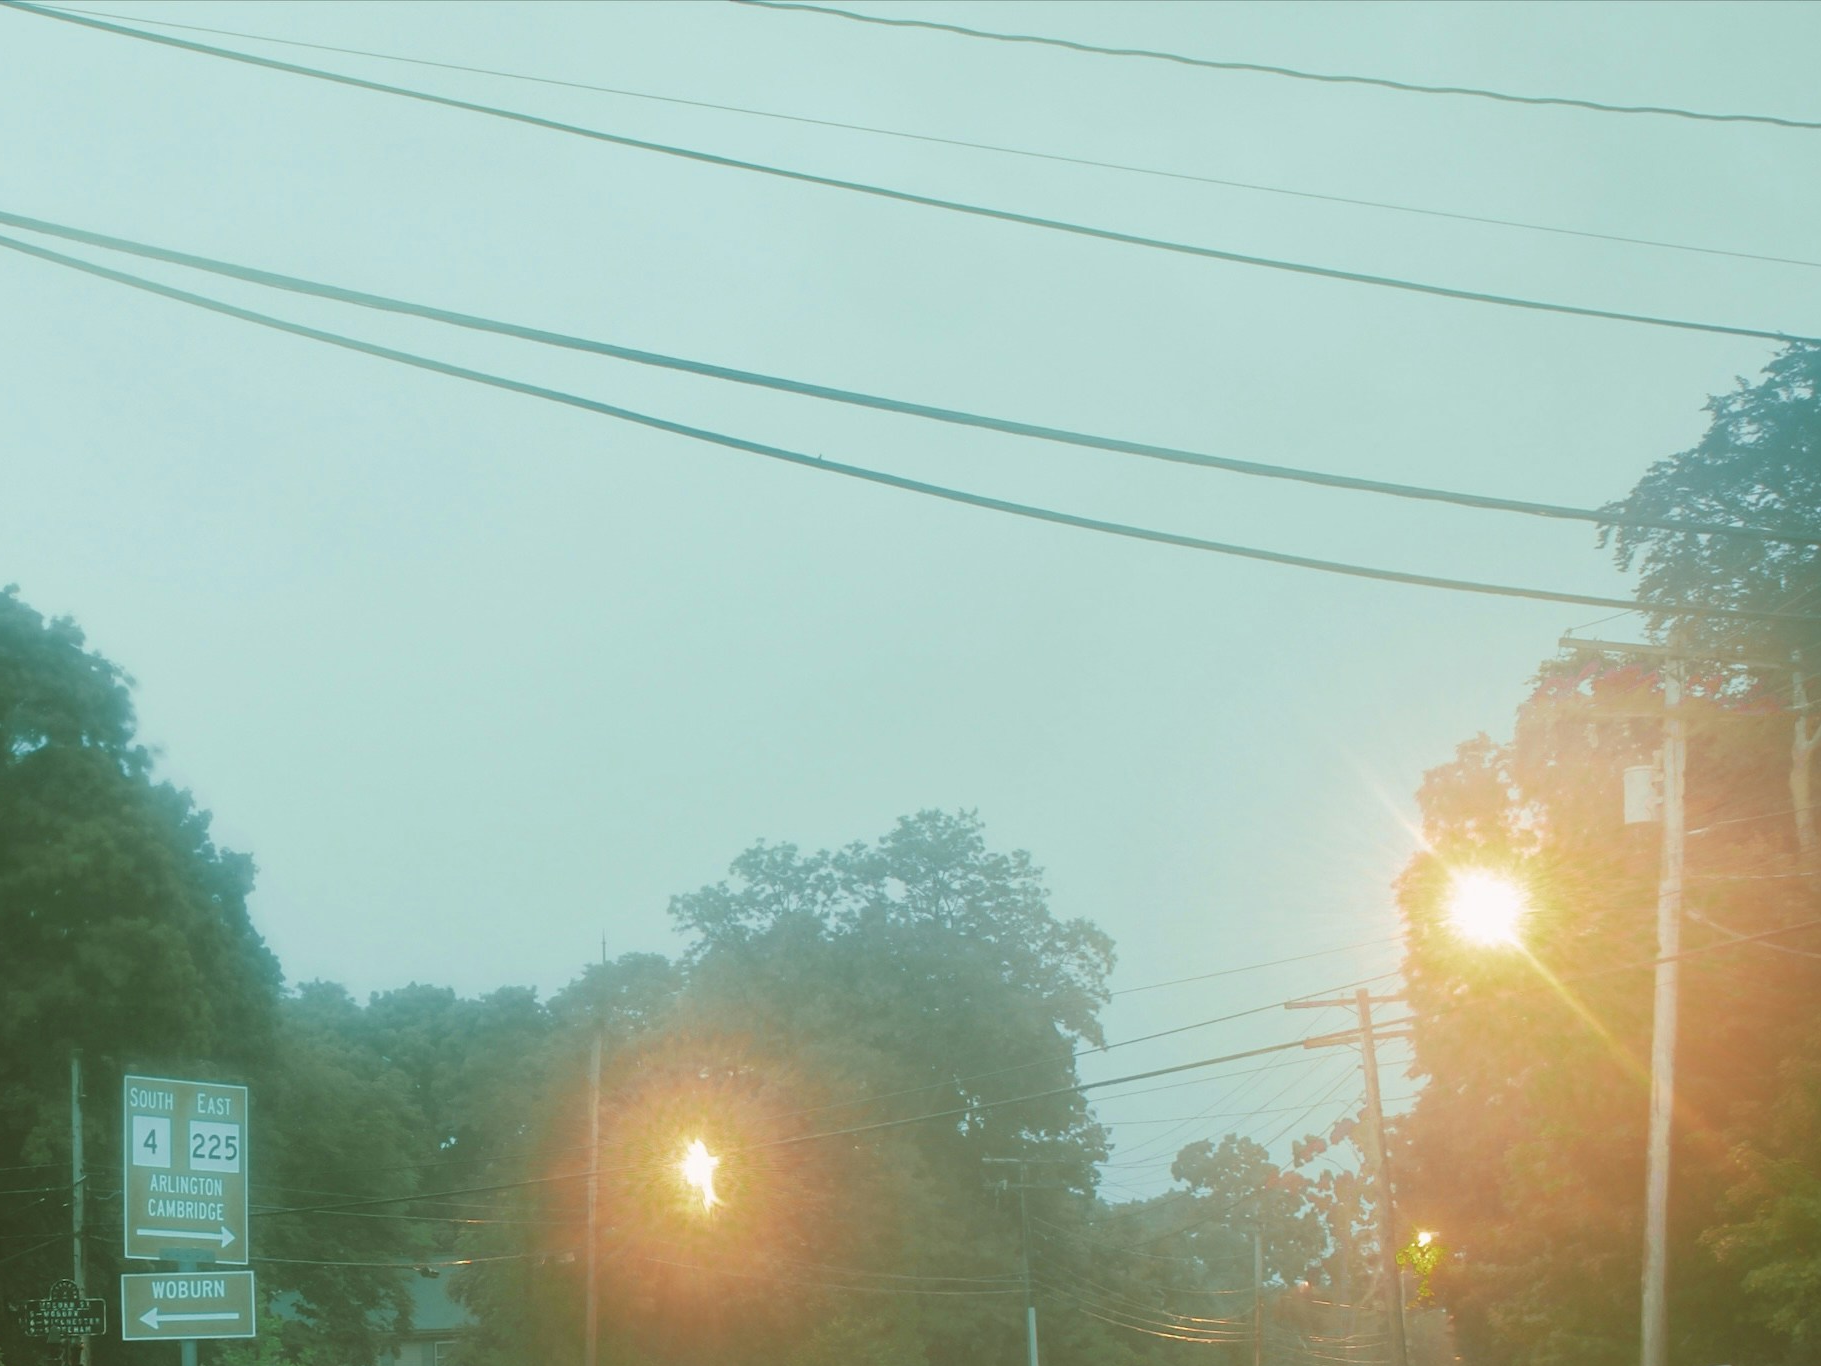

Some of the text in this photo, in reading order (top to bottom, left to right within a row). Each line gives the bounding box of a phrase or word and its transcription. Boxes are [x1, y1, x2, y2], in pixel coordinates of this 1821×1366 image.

[130, 1087, 173, 1110] SOUTH
[197, 1093, 231, 1116] EAST
[143, 1128, 158, 1155] 4
[192, 1133, 238, 1161] 225
[150, 1174, 223, 1197] ARLINGTON
[148, 1199, 224, 1221] CAMBRIDGE
[152, 1280, 225, 1299] WOBURN
